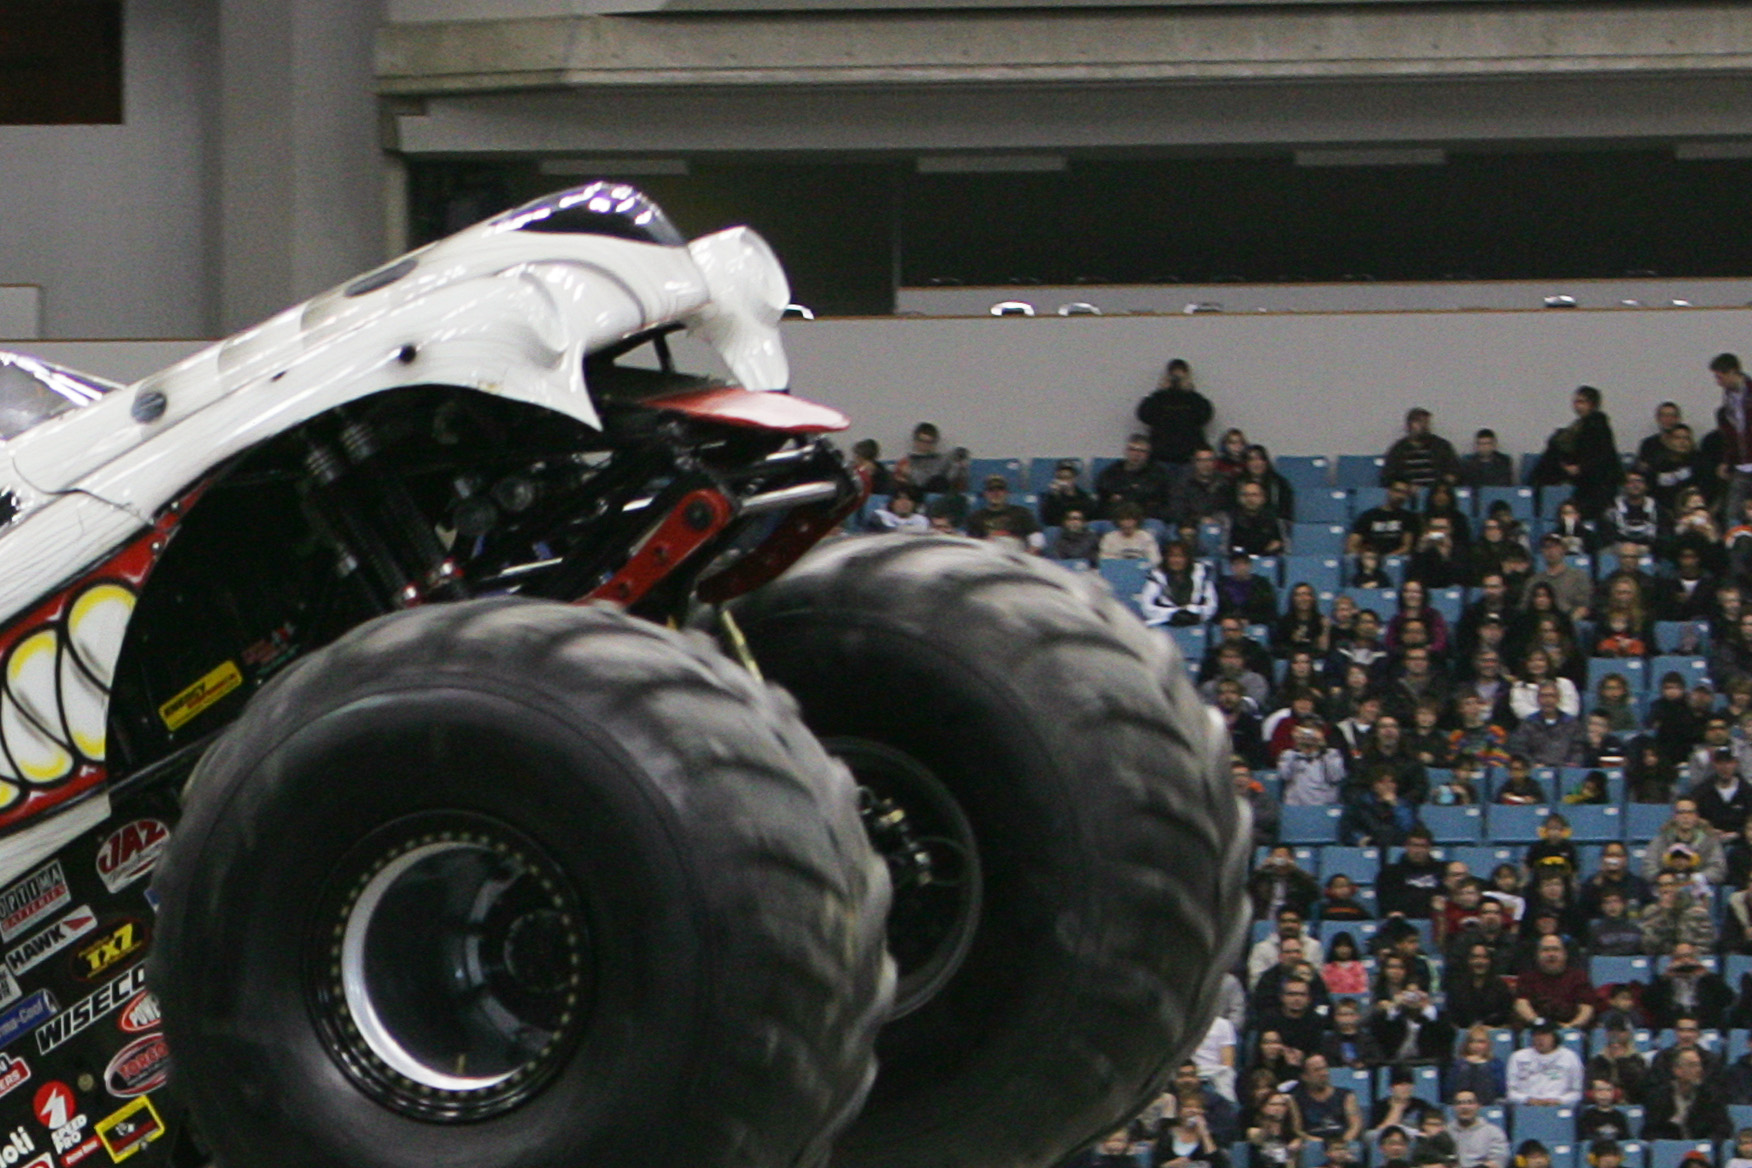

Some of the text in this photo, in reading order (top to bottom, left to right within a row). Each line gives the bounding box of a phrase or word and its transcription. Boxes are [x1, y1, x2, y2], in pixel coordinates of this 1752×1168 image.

[98, 818, 167, 875] JAZ
[7, 922, 67, 971] HAWK
[51, 1113, 88, 1141] SPEED
[52, 1130, 82, 1155] PRO
